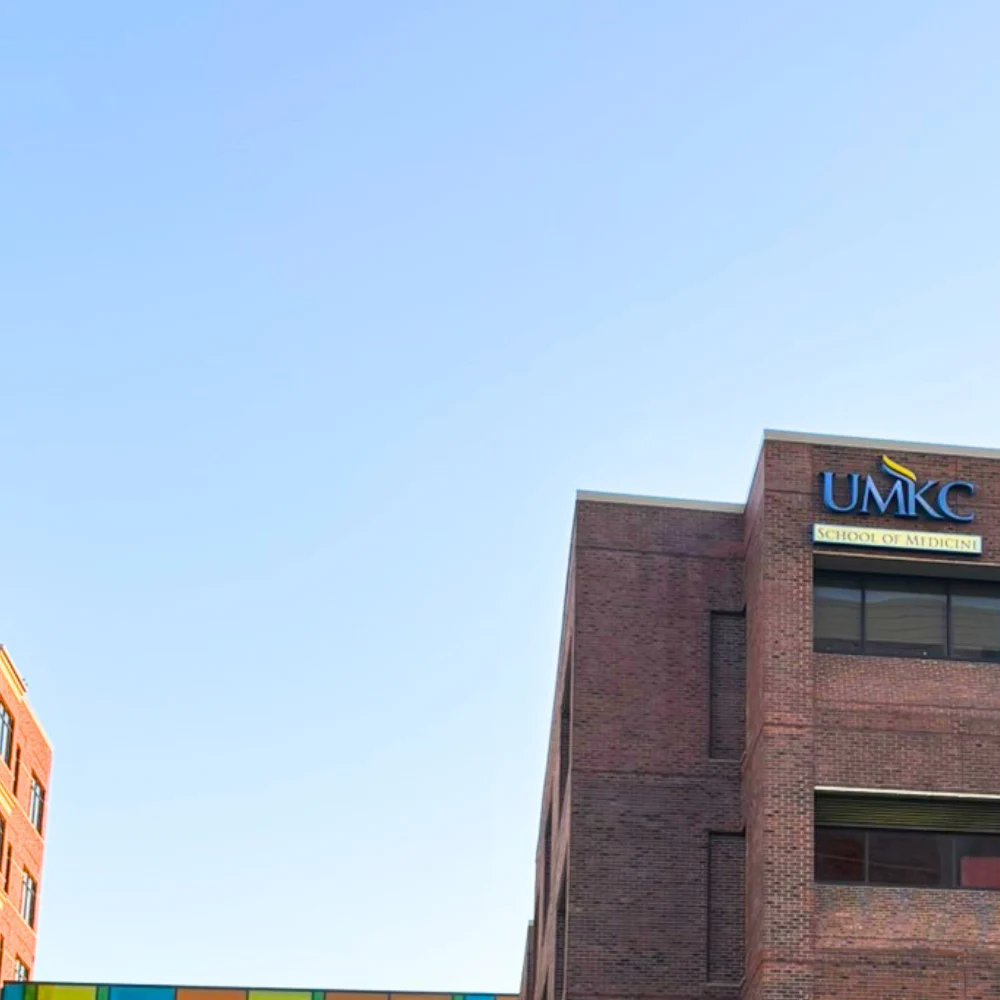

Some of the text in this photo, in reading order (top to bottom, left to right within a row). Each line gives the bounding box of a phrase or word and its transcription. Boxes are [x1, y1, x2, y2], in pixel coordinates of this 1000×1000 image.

[820, 464, 977, 523] UMKC
[817, 527, 877, 543] SCHOOL
[882, 533, 901, 545] OF
